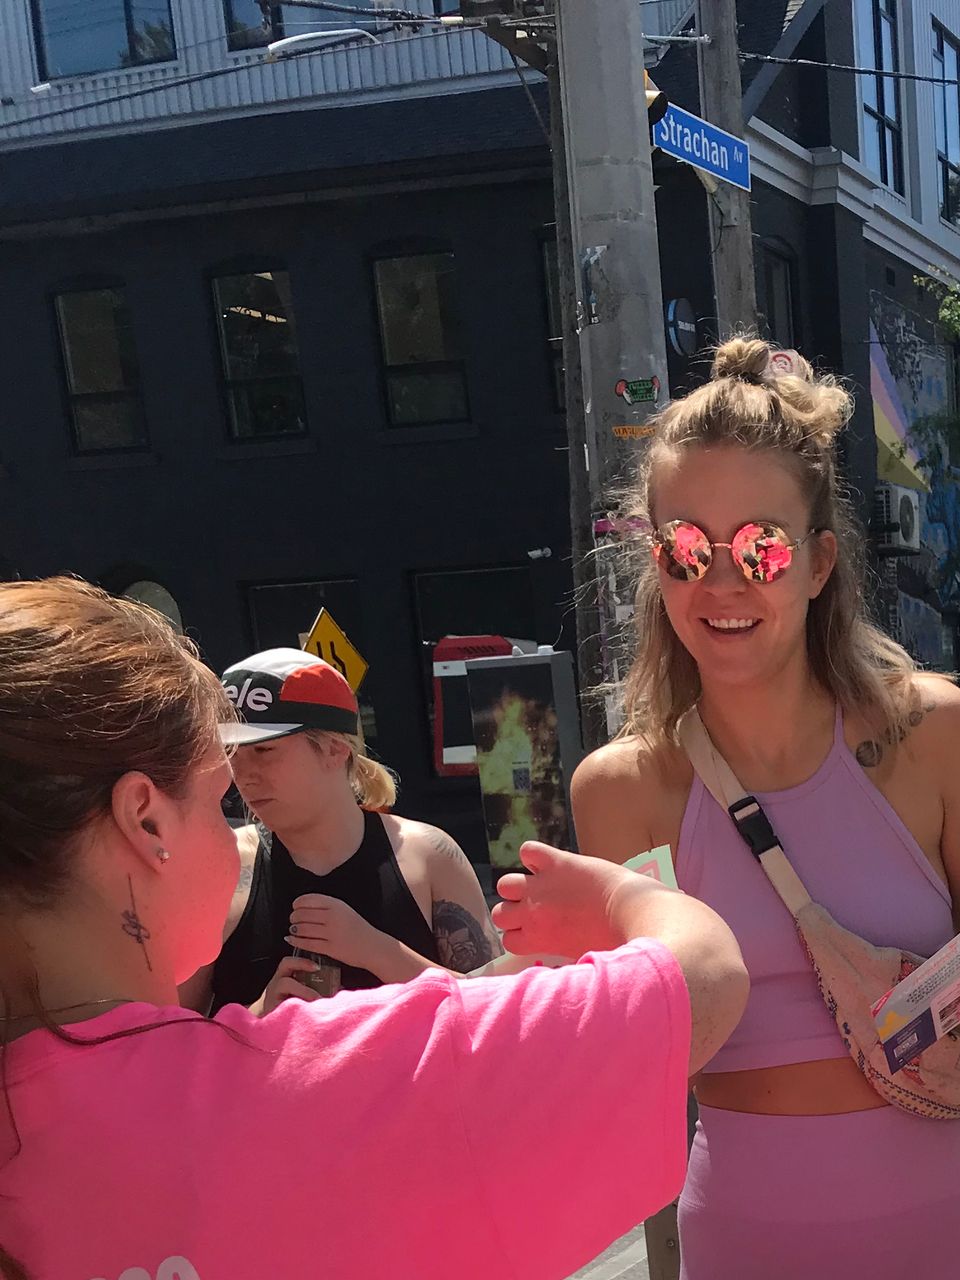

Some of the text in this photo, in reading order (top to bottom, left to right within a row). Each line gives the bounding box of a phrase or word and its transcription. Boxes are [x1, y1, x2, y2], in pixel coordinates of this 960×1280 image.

[660, 112, 743, 171] Strachan Av
[222, 678, 273, 712] ele
